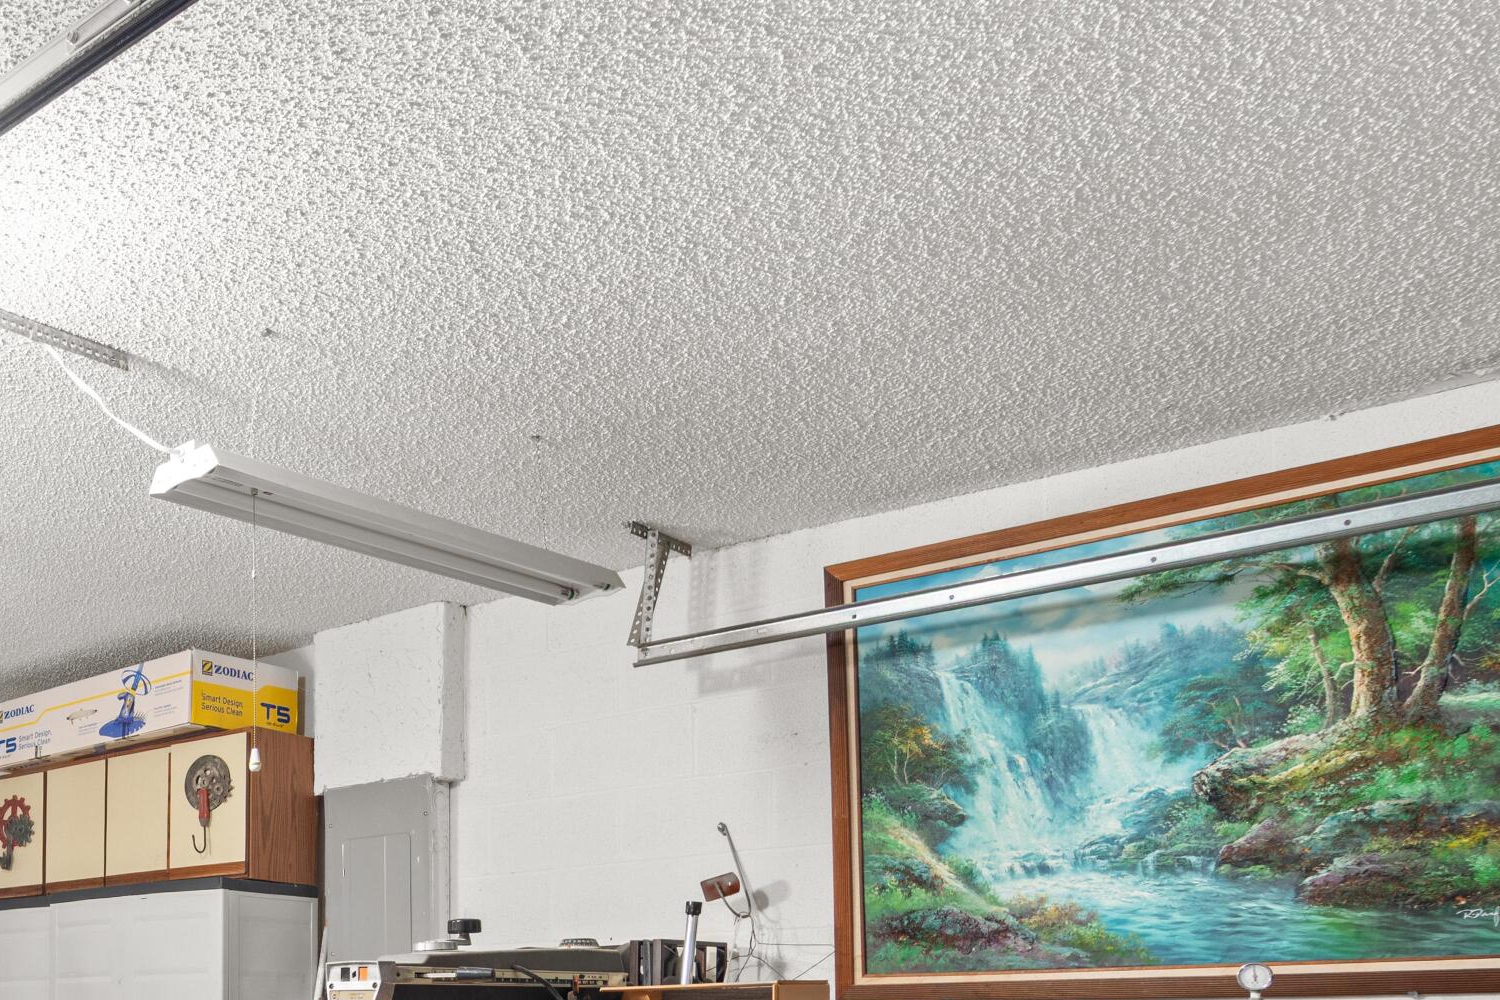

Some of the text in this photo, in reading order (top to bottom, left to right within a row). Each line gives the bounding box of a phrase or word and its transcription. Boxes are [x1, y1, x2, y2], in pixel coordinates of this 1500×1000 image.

[213, 664, 254, 682] ZODIAC
[201, 692, 221, 703] Smart
[3, 704, 35, 720] ZODIAC
[201, 702, 243, 717] Serious Clean
[260, 702, 291, 724] T5
[18, 732, 33, 743] Smart
[18, 737, 51, 751] Serious Clean
